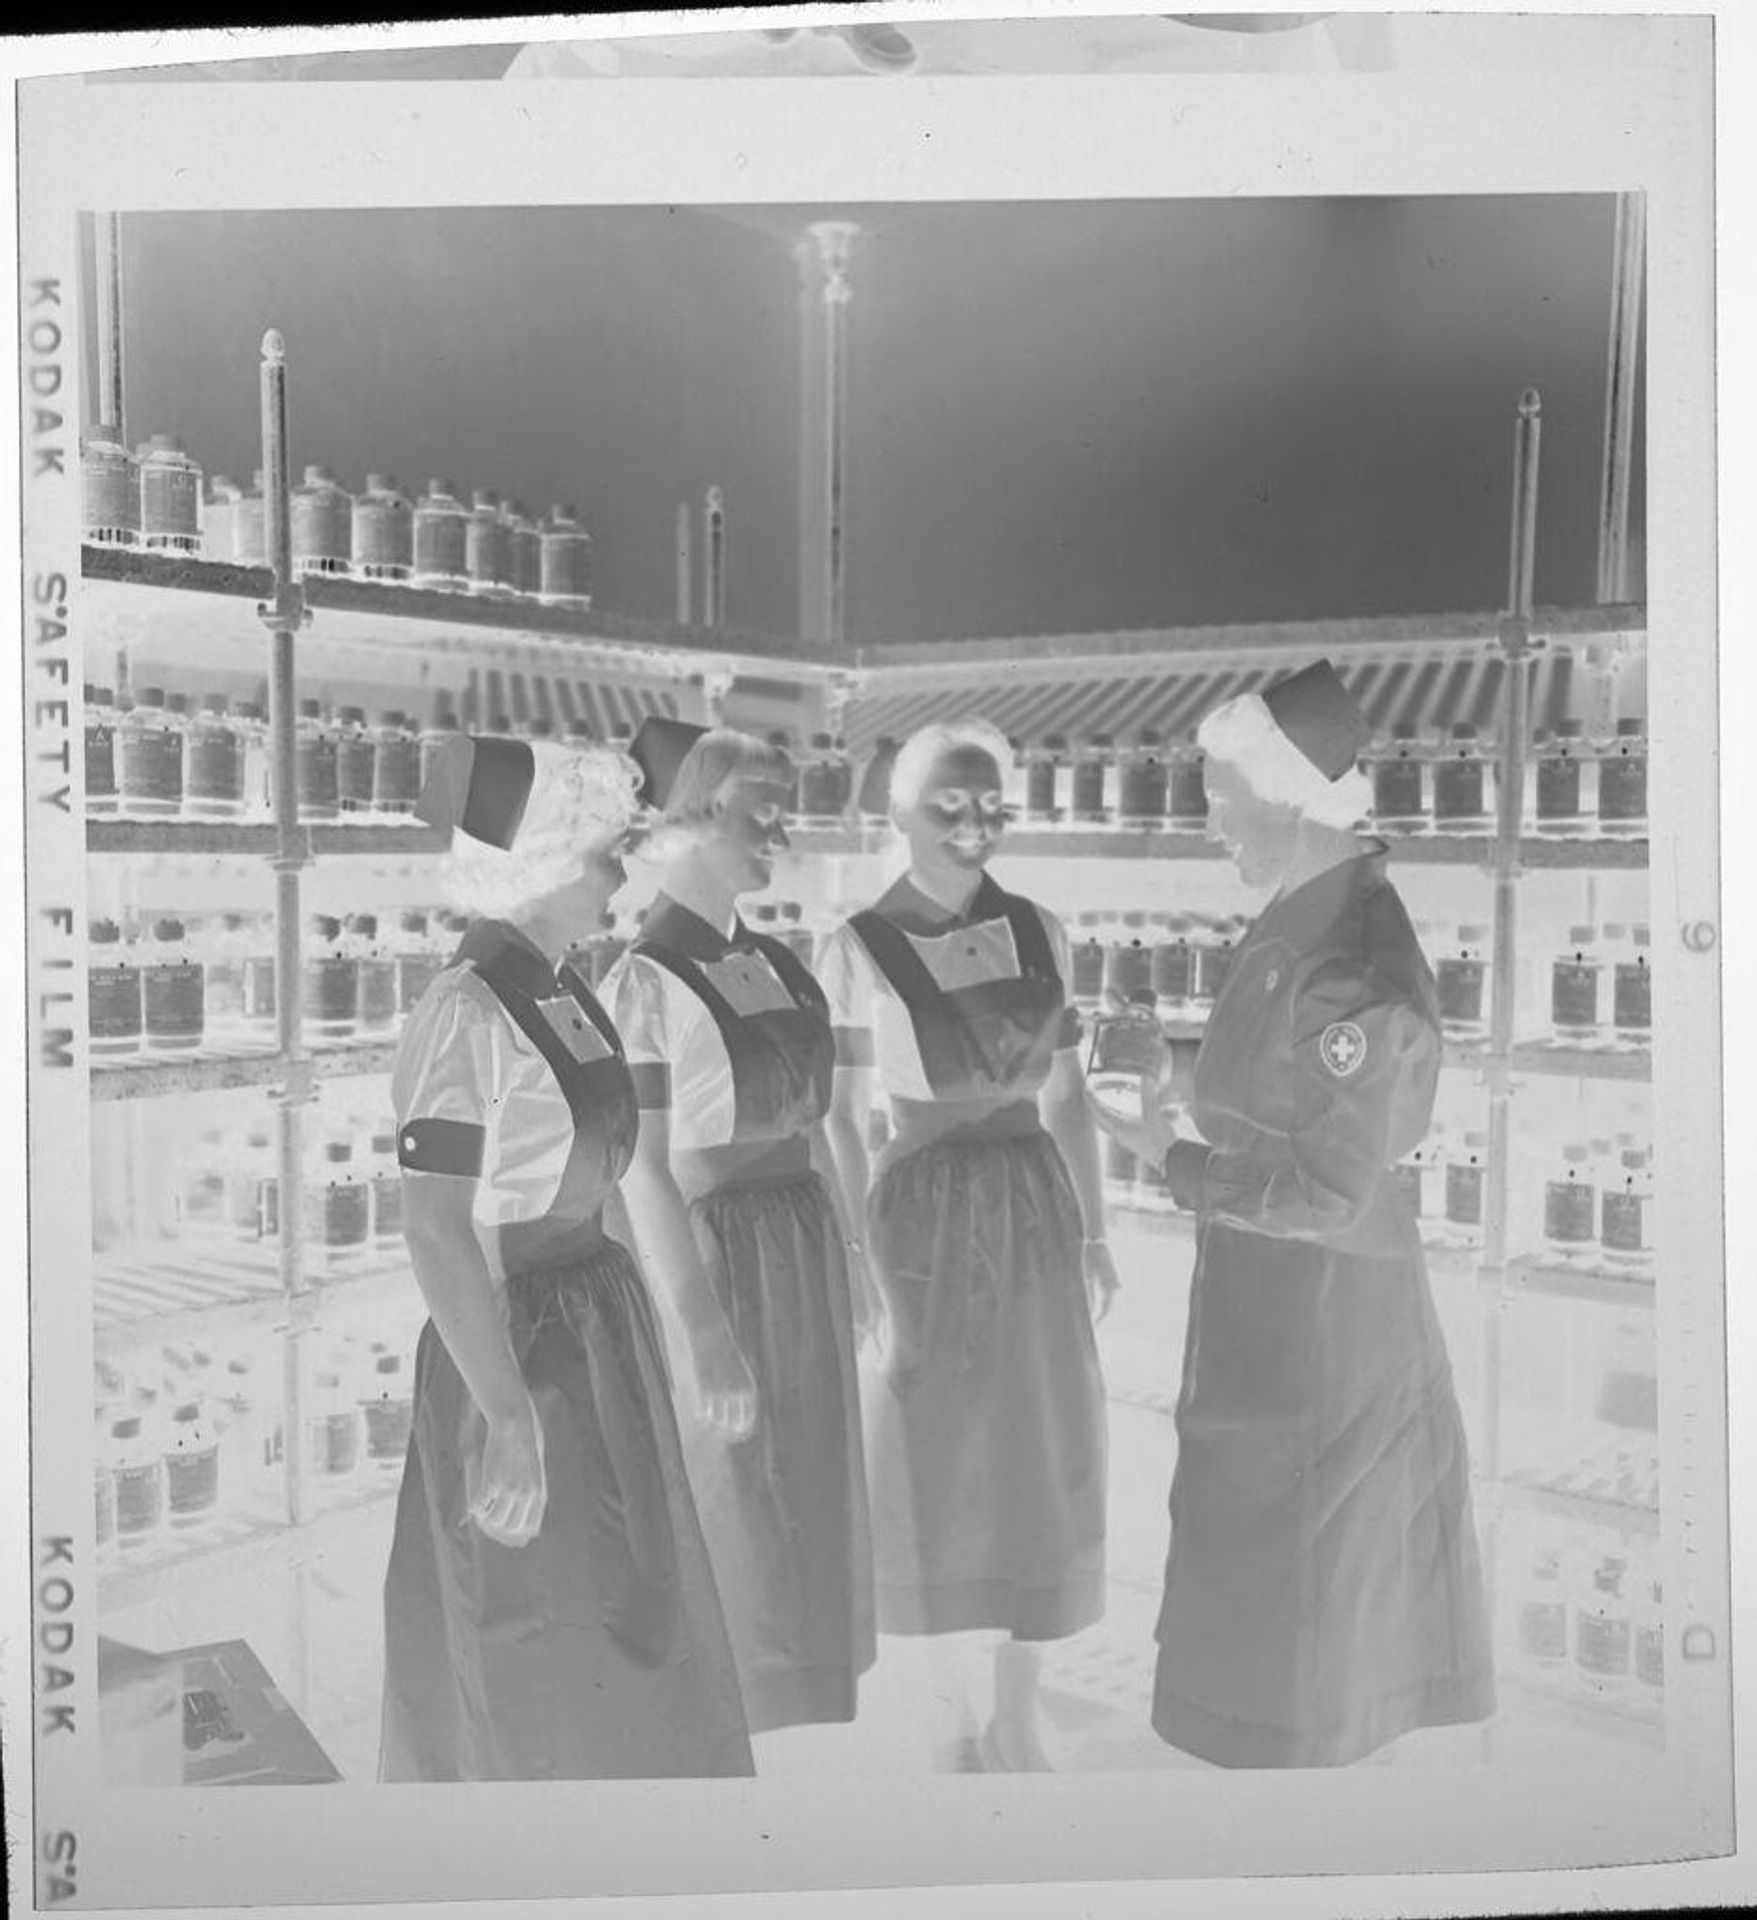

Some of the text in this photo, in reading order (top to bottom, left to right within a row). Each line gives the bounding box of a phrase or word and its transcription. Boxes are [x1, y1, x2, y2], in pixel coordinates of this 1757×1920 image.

[29, 279, 64, 477] KODAK
[40, 907, 74, 1068] FILM
[40, 1536, 76, 1735] KODAK
